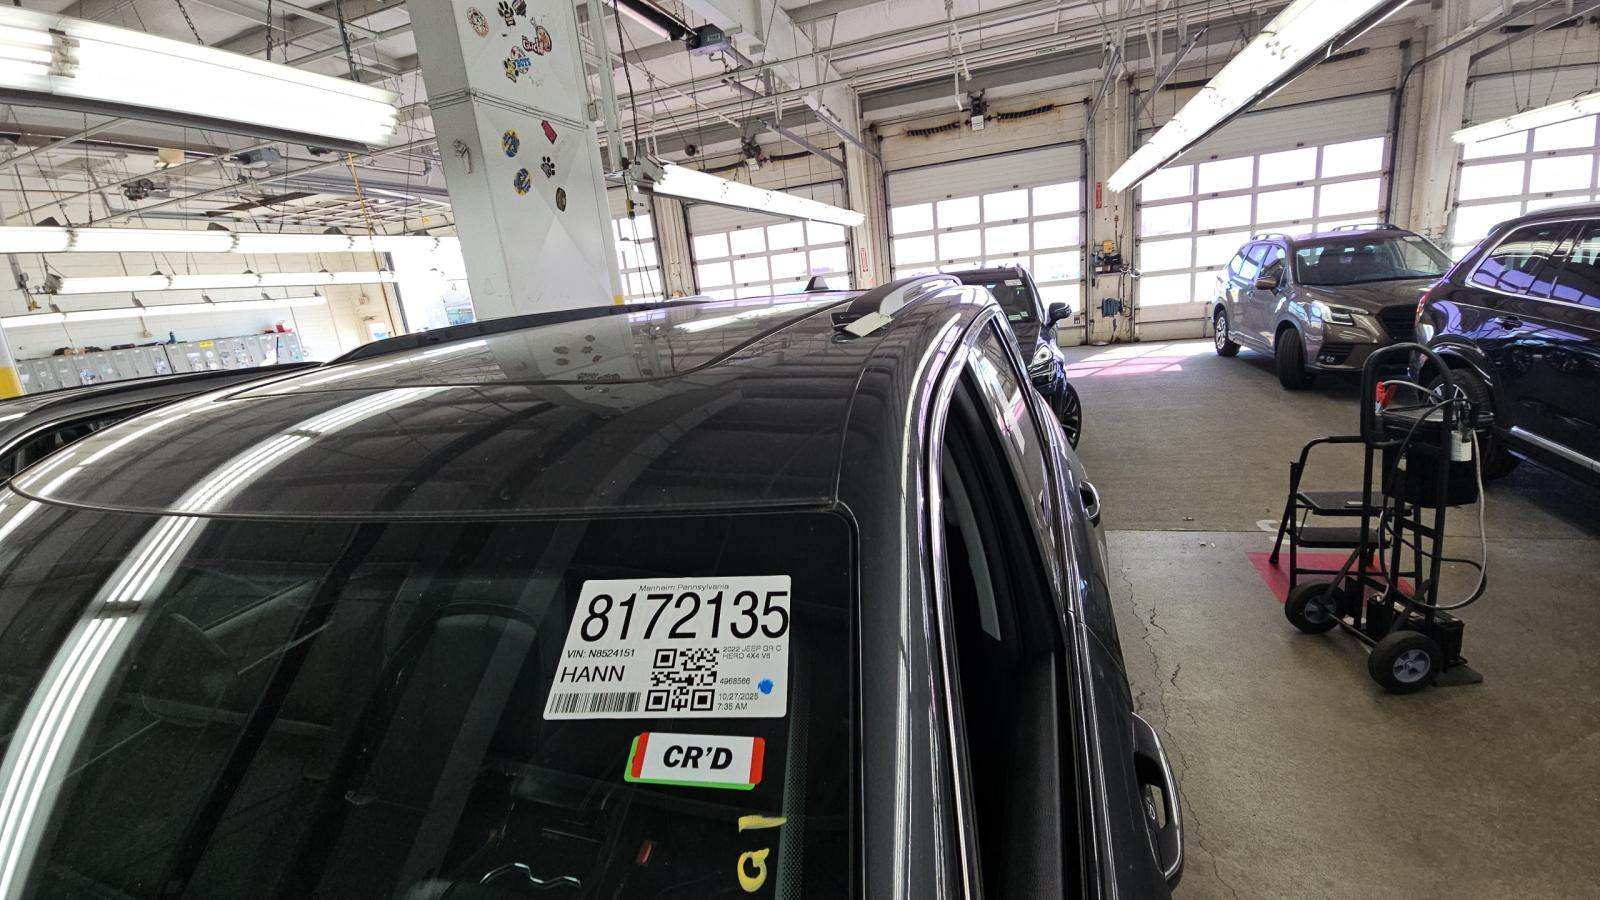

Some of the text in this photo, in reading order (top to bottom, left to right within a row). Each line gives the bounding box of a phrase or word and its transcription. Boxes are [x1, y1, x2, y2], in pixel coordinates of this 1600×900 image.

[638, 582, 730, 593] Manheim Pennsylvania
[580, 590, 790, 642] 8172135
[567, 648, 635, 658] VIN: N8524151
[560, 665, 626, 683] HANN
[734, 702, 748, 710] AM
[663, 745, 733, 770] CR'D
